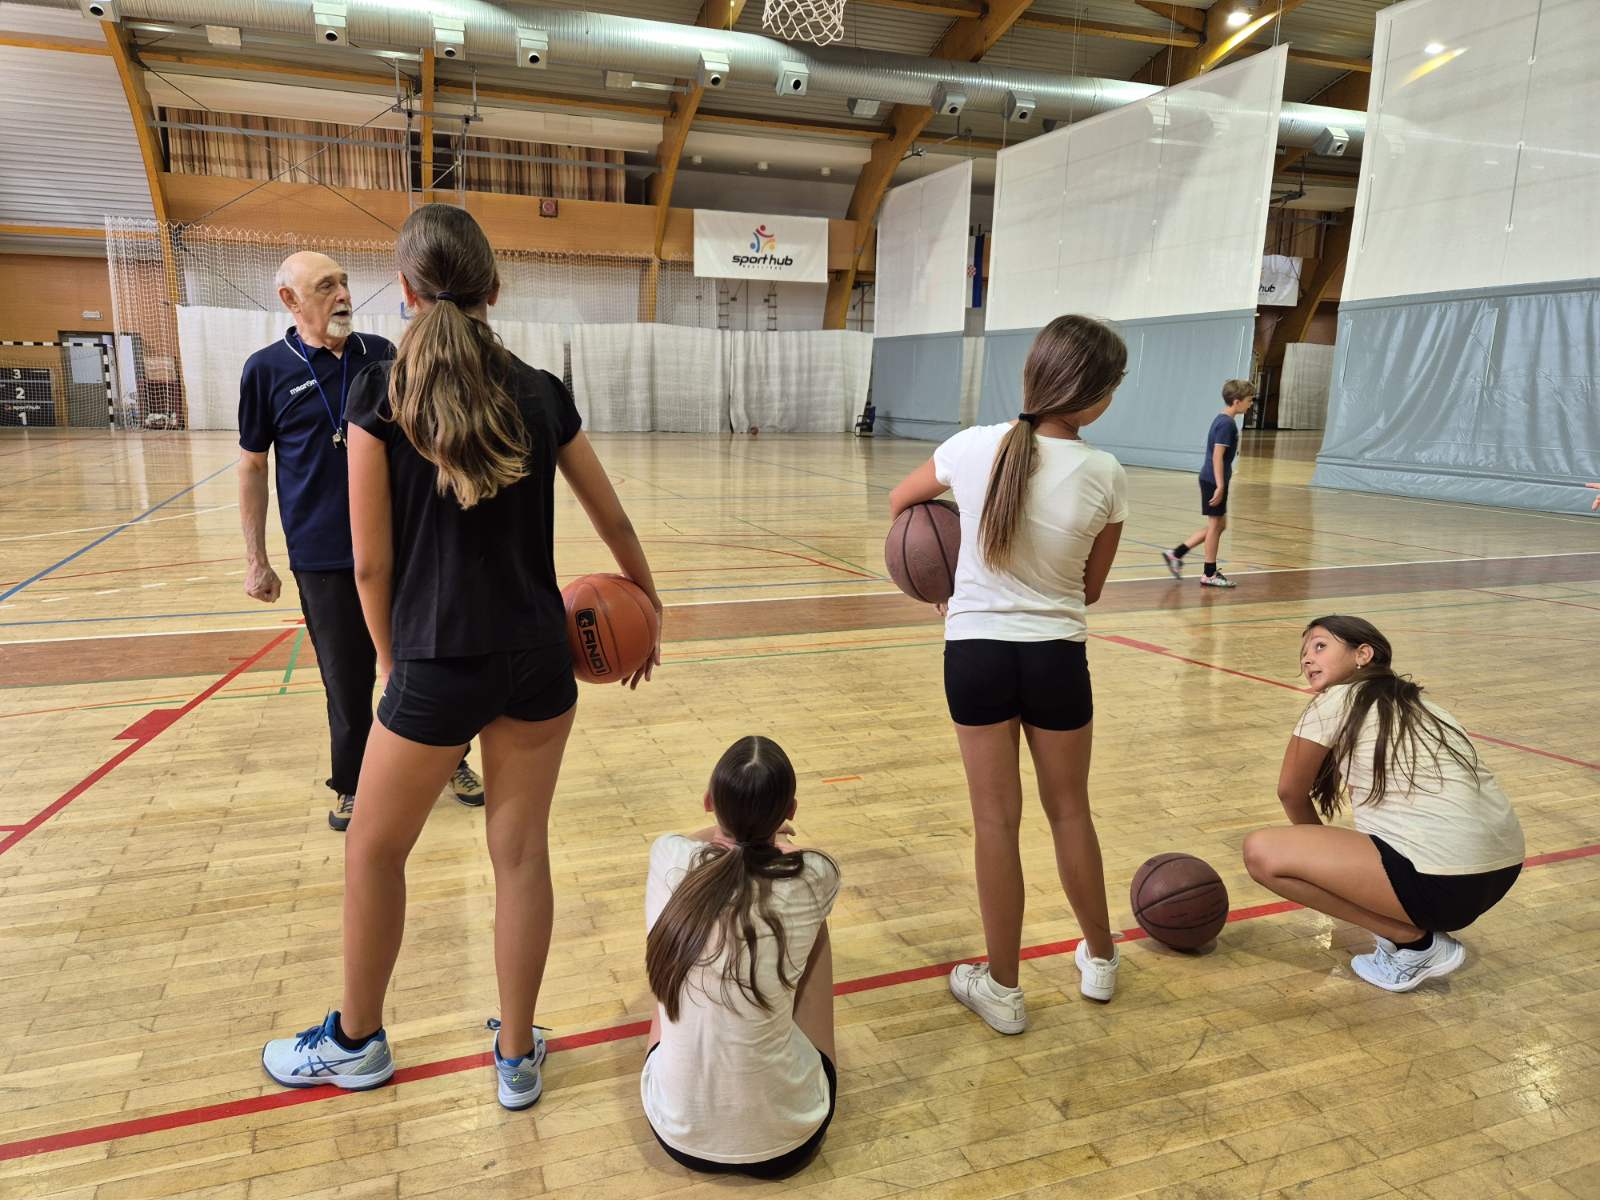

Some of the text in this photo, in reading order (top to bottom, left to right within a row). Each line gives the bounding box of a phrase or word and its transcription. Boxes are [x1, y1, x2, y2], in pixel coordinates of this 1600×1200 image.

[732, 254, 793, 266] sport hub
[12, 369, 21, 379] 3
[15, 387, 26, 400] 2
[18, 412, 28, 425] 1
